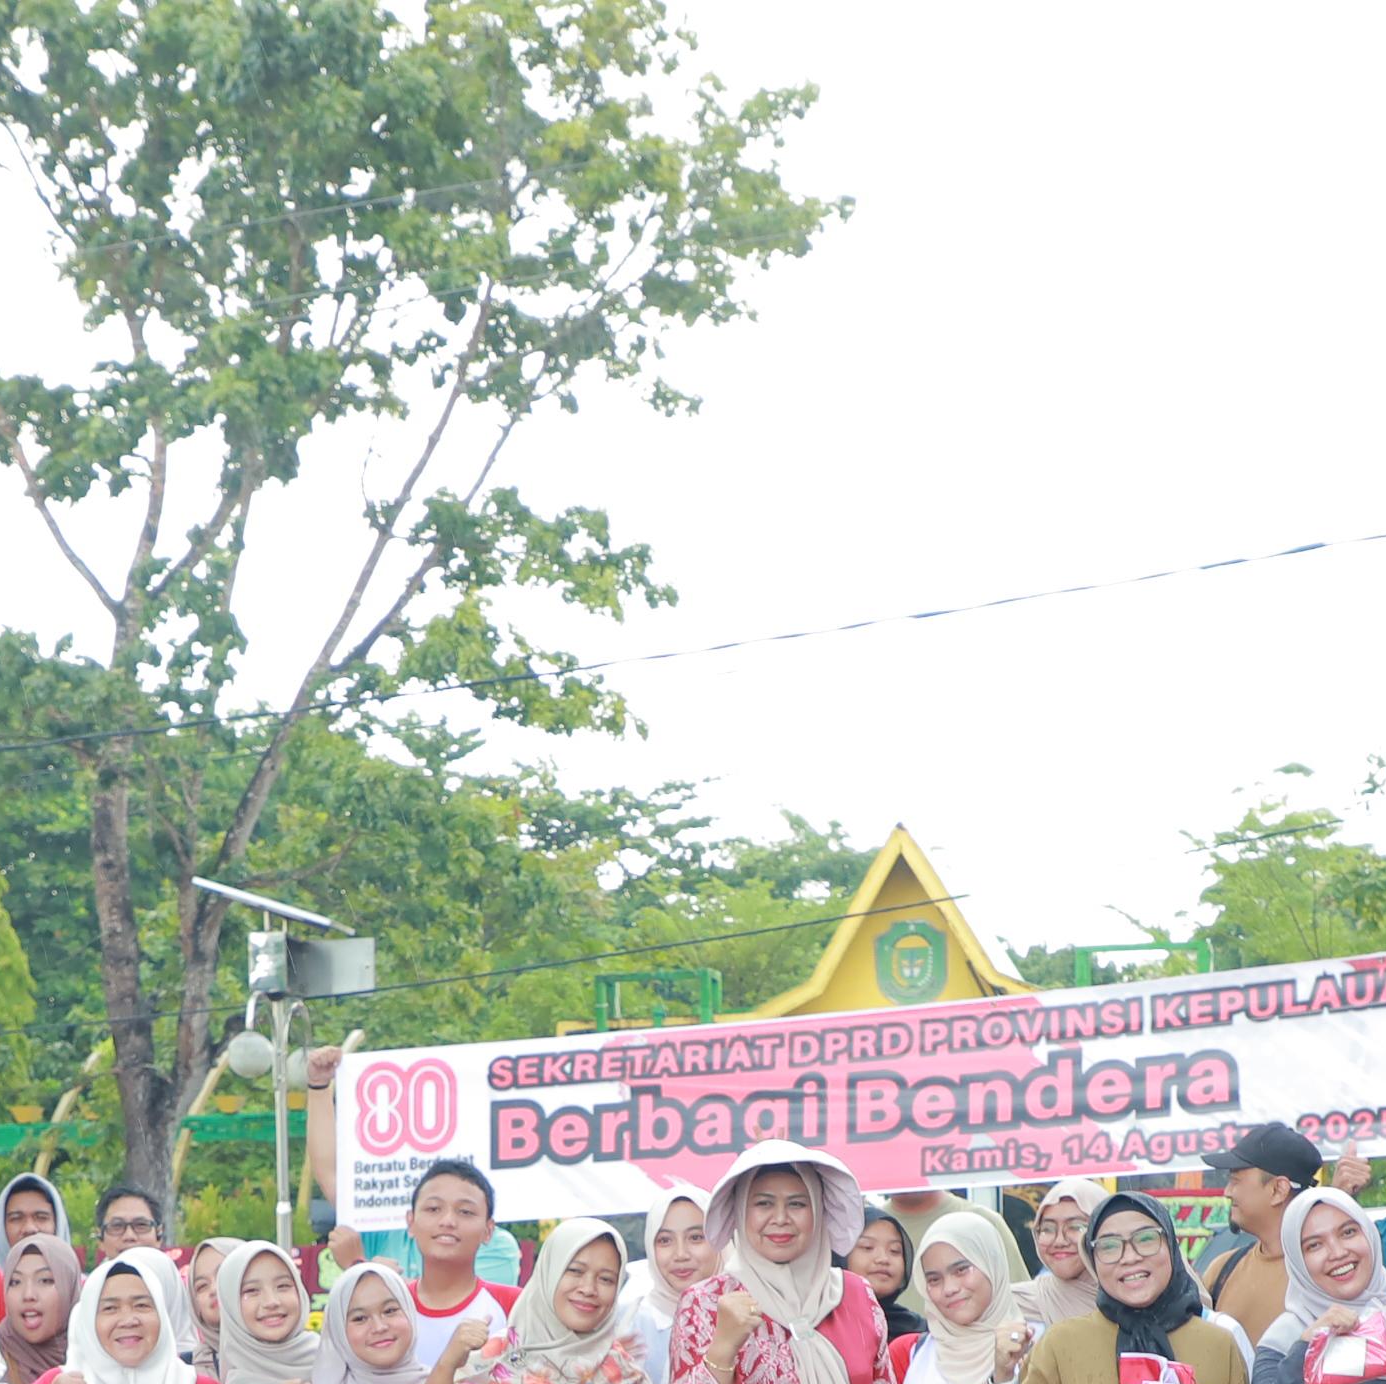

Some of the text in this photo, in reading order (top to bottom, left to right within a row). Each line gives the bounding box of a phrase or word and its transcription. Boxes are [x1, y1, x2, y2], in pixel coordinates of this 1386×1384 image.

[490, 1037, 781, 1090] SEKRETARIAT
[796, 1028, 910, 1064] DPRD
[921, 1000, 1140, 1053] PROVINSI
[355, 1058, 458, 1157] 80
[493, 1050, 1241, 1168] Berbagi Bendera
[354, 1160, 406, 1174] Bersatu
[921, 1137, 1054, 1176] Kamis,
[1063, 1130, 1113, 1165] 14
[1116, 1122, 1251, 1170] Agust
[354, 1178, 400, 1193] Rakyat
[354, 1194, 412, 1209] Indonesi
